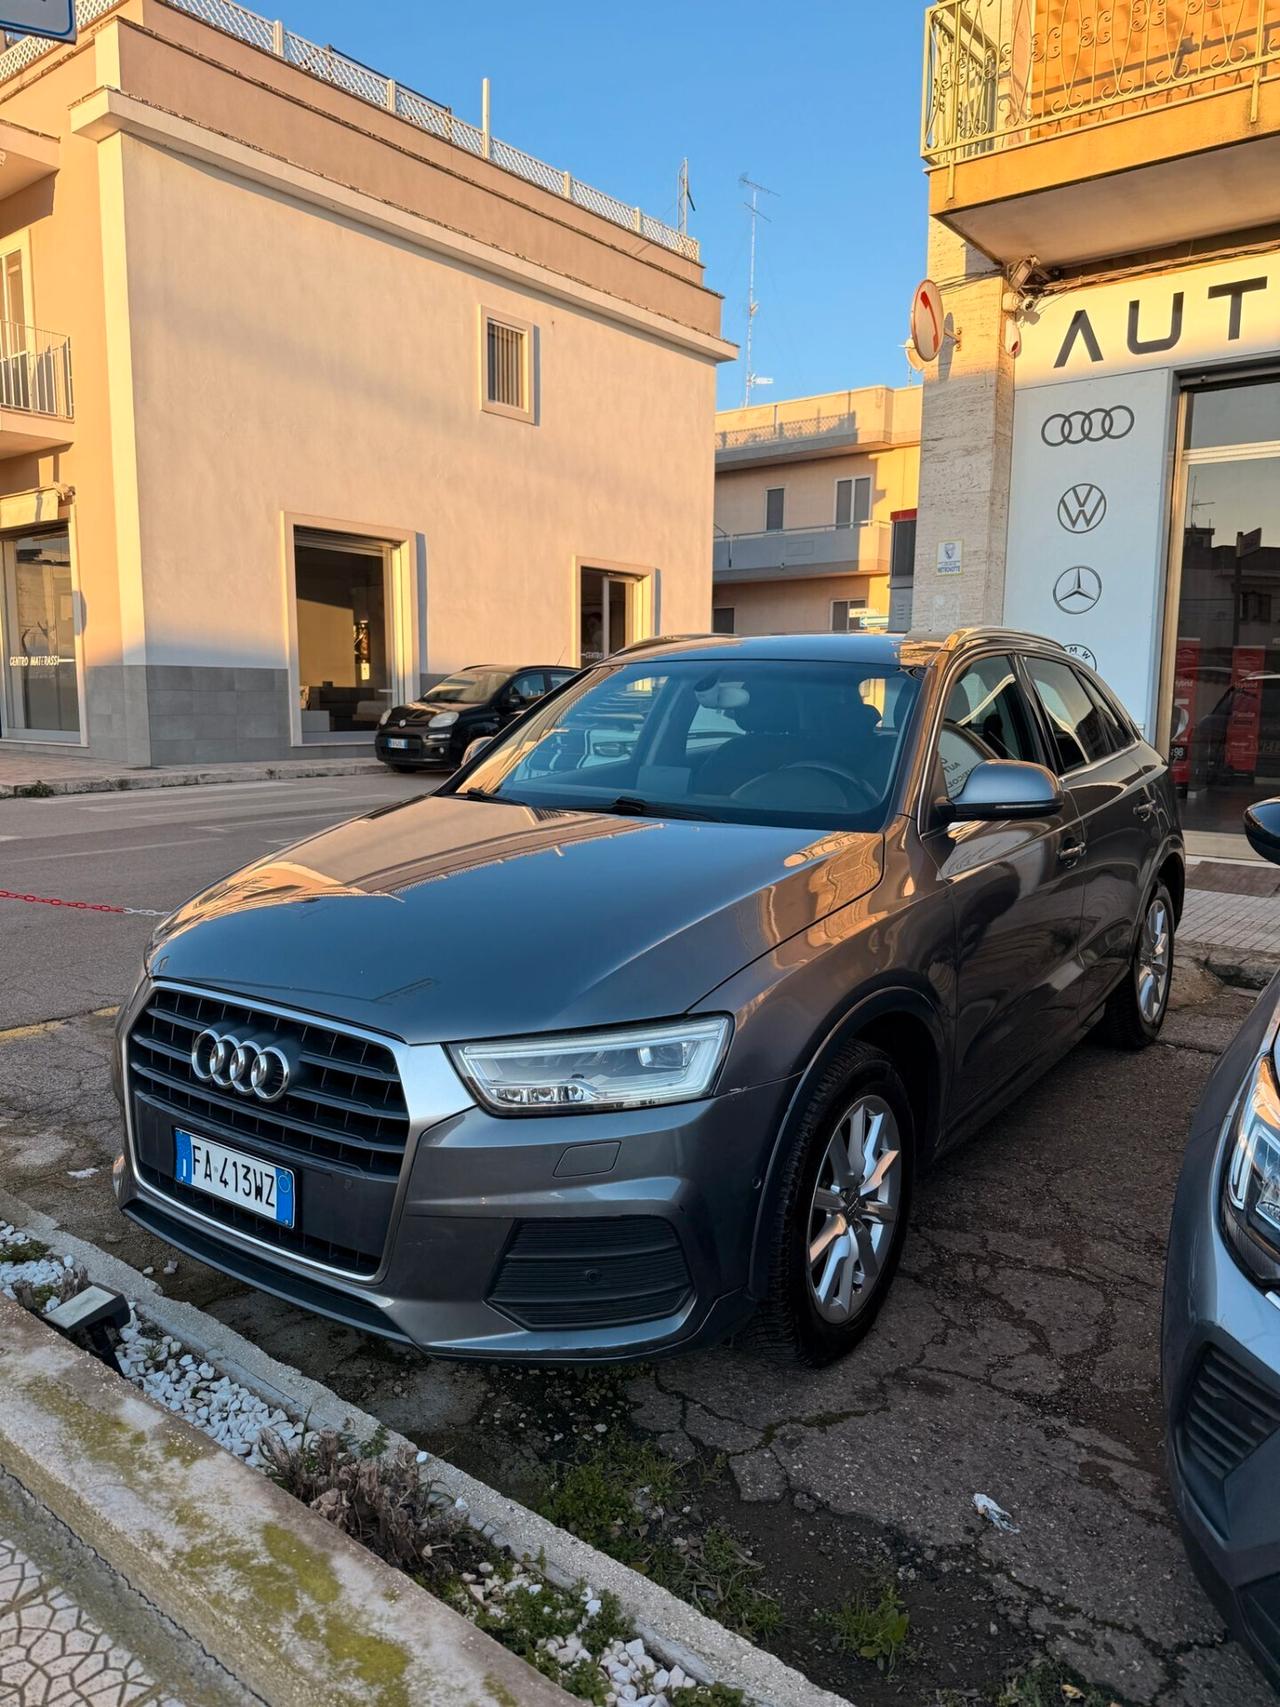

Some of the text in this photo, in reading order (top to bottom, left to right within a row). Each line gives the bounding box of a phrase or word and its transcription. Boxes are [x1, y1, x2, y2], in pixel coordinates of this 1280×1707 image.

[9, 655, 60, 667] CENTRO MATERASSI
[192, 1144, 212, 1182] FA
[219, 1157, 275, 1208] 413WZ
